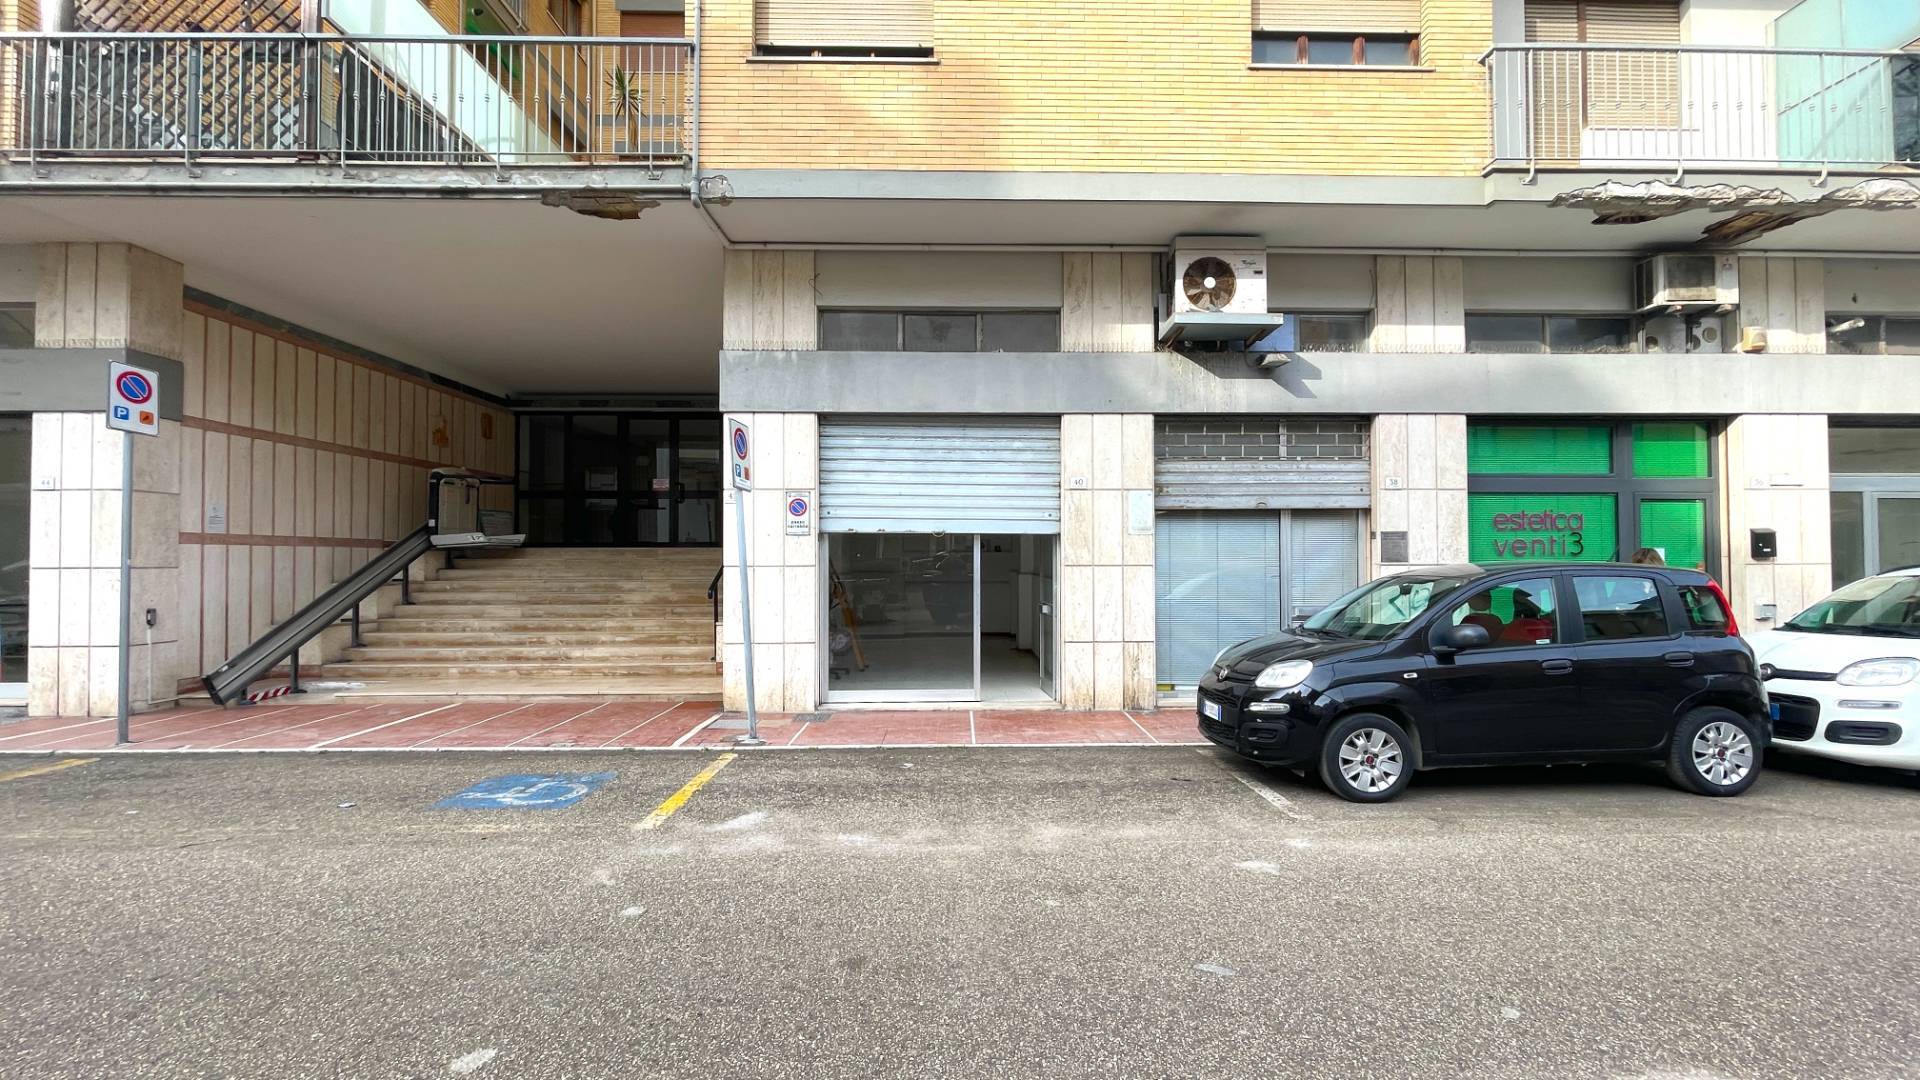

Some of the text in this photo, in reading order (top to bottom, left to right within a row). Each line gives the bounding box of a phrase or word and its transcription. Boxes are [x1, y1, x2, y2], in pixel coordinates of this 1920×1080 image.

[117, 407, 127, 418] P
[1493, 510, 1584, 532] estetica
[1494, 532, 1584, 557] venti3
